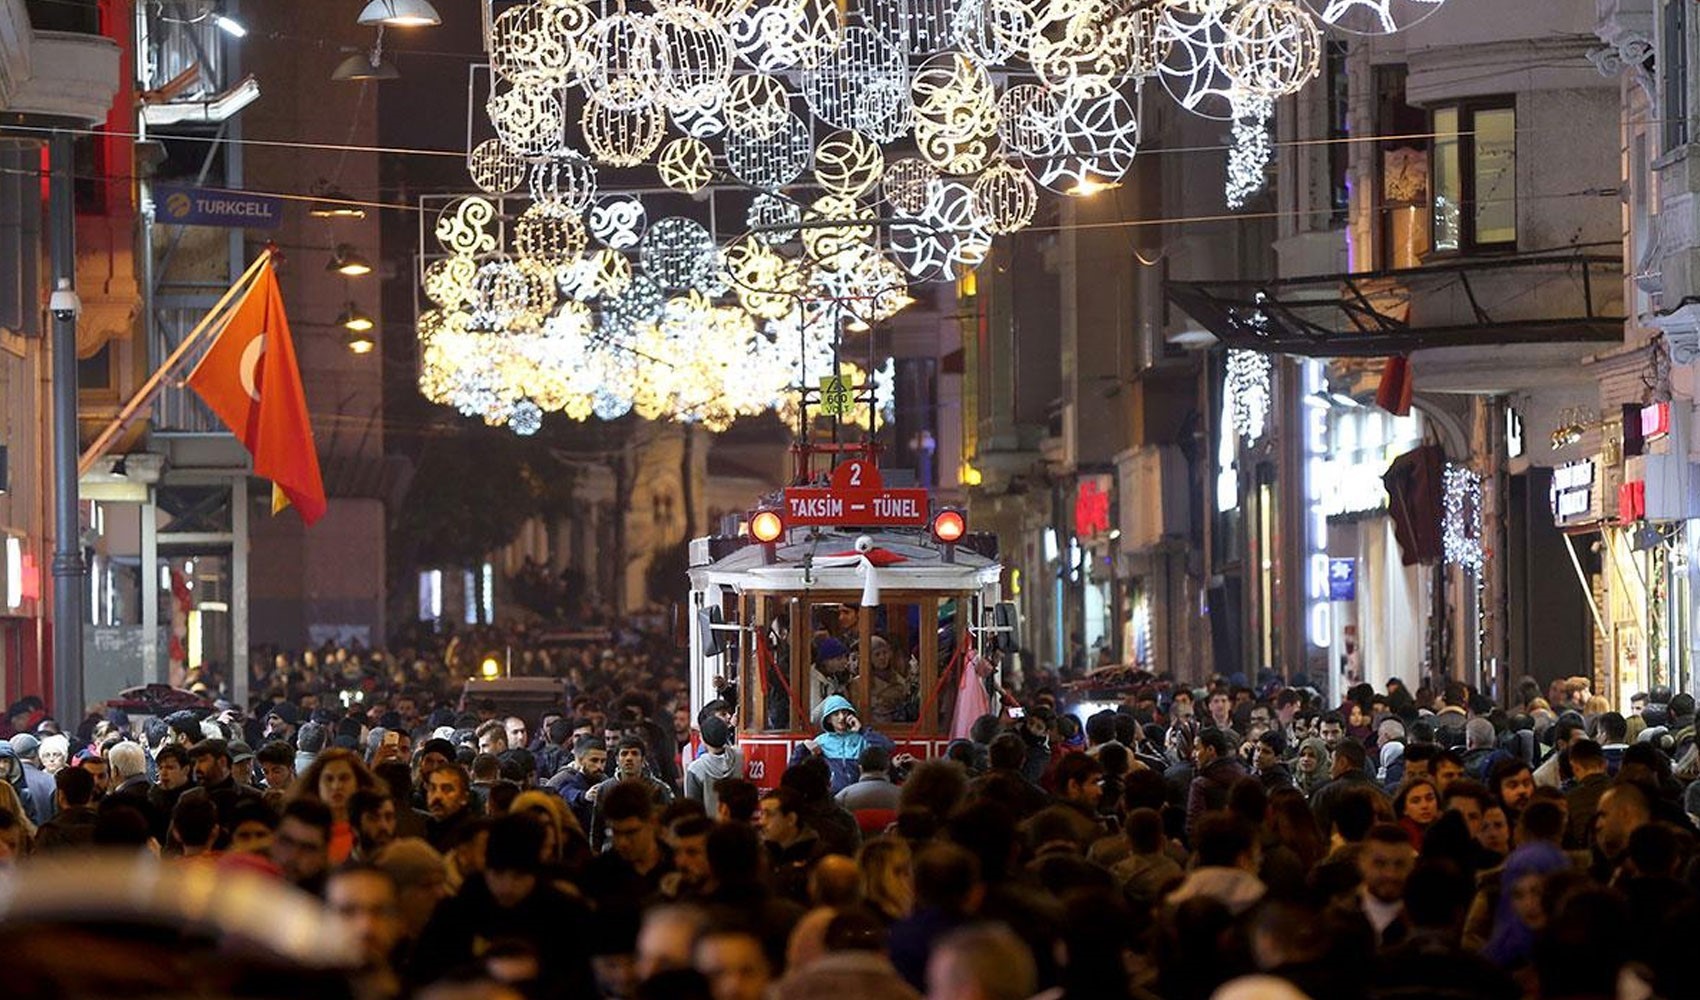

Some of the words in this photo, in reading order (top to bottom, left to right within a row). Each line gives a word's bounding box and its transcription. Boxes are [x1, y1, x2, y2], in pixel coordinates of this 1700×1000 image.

[196, 200, 272, 216] TURKCELL
[850, 463, 861, 486] 2
[790, 494, 843, 517] TAKSİM
[873, 494, 919, 517] TÜNEL
[749, 760, 765, 779] 223
